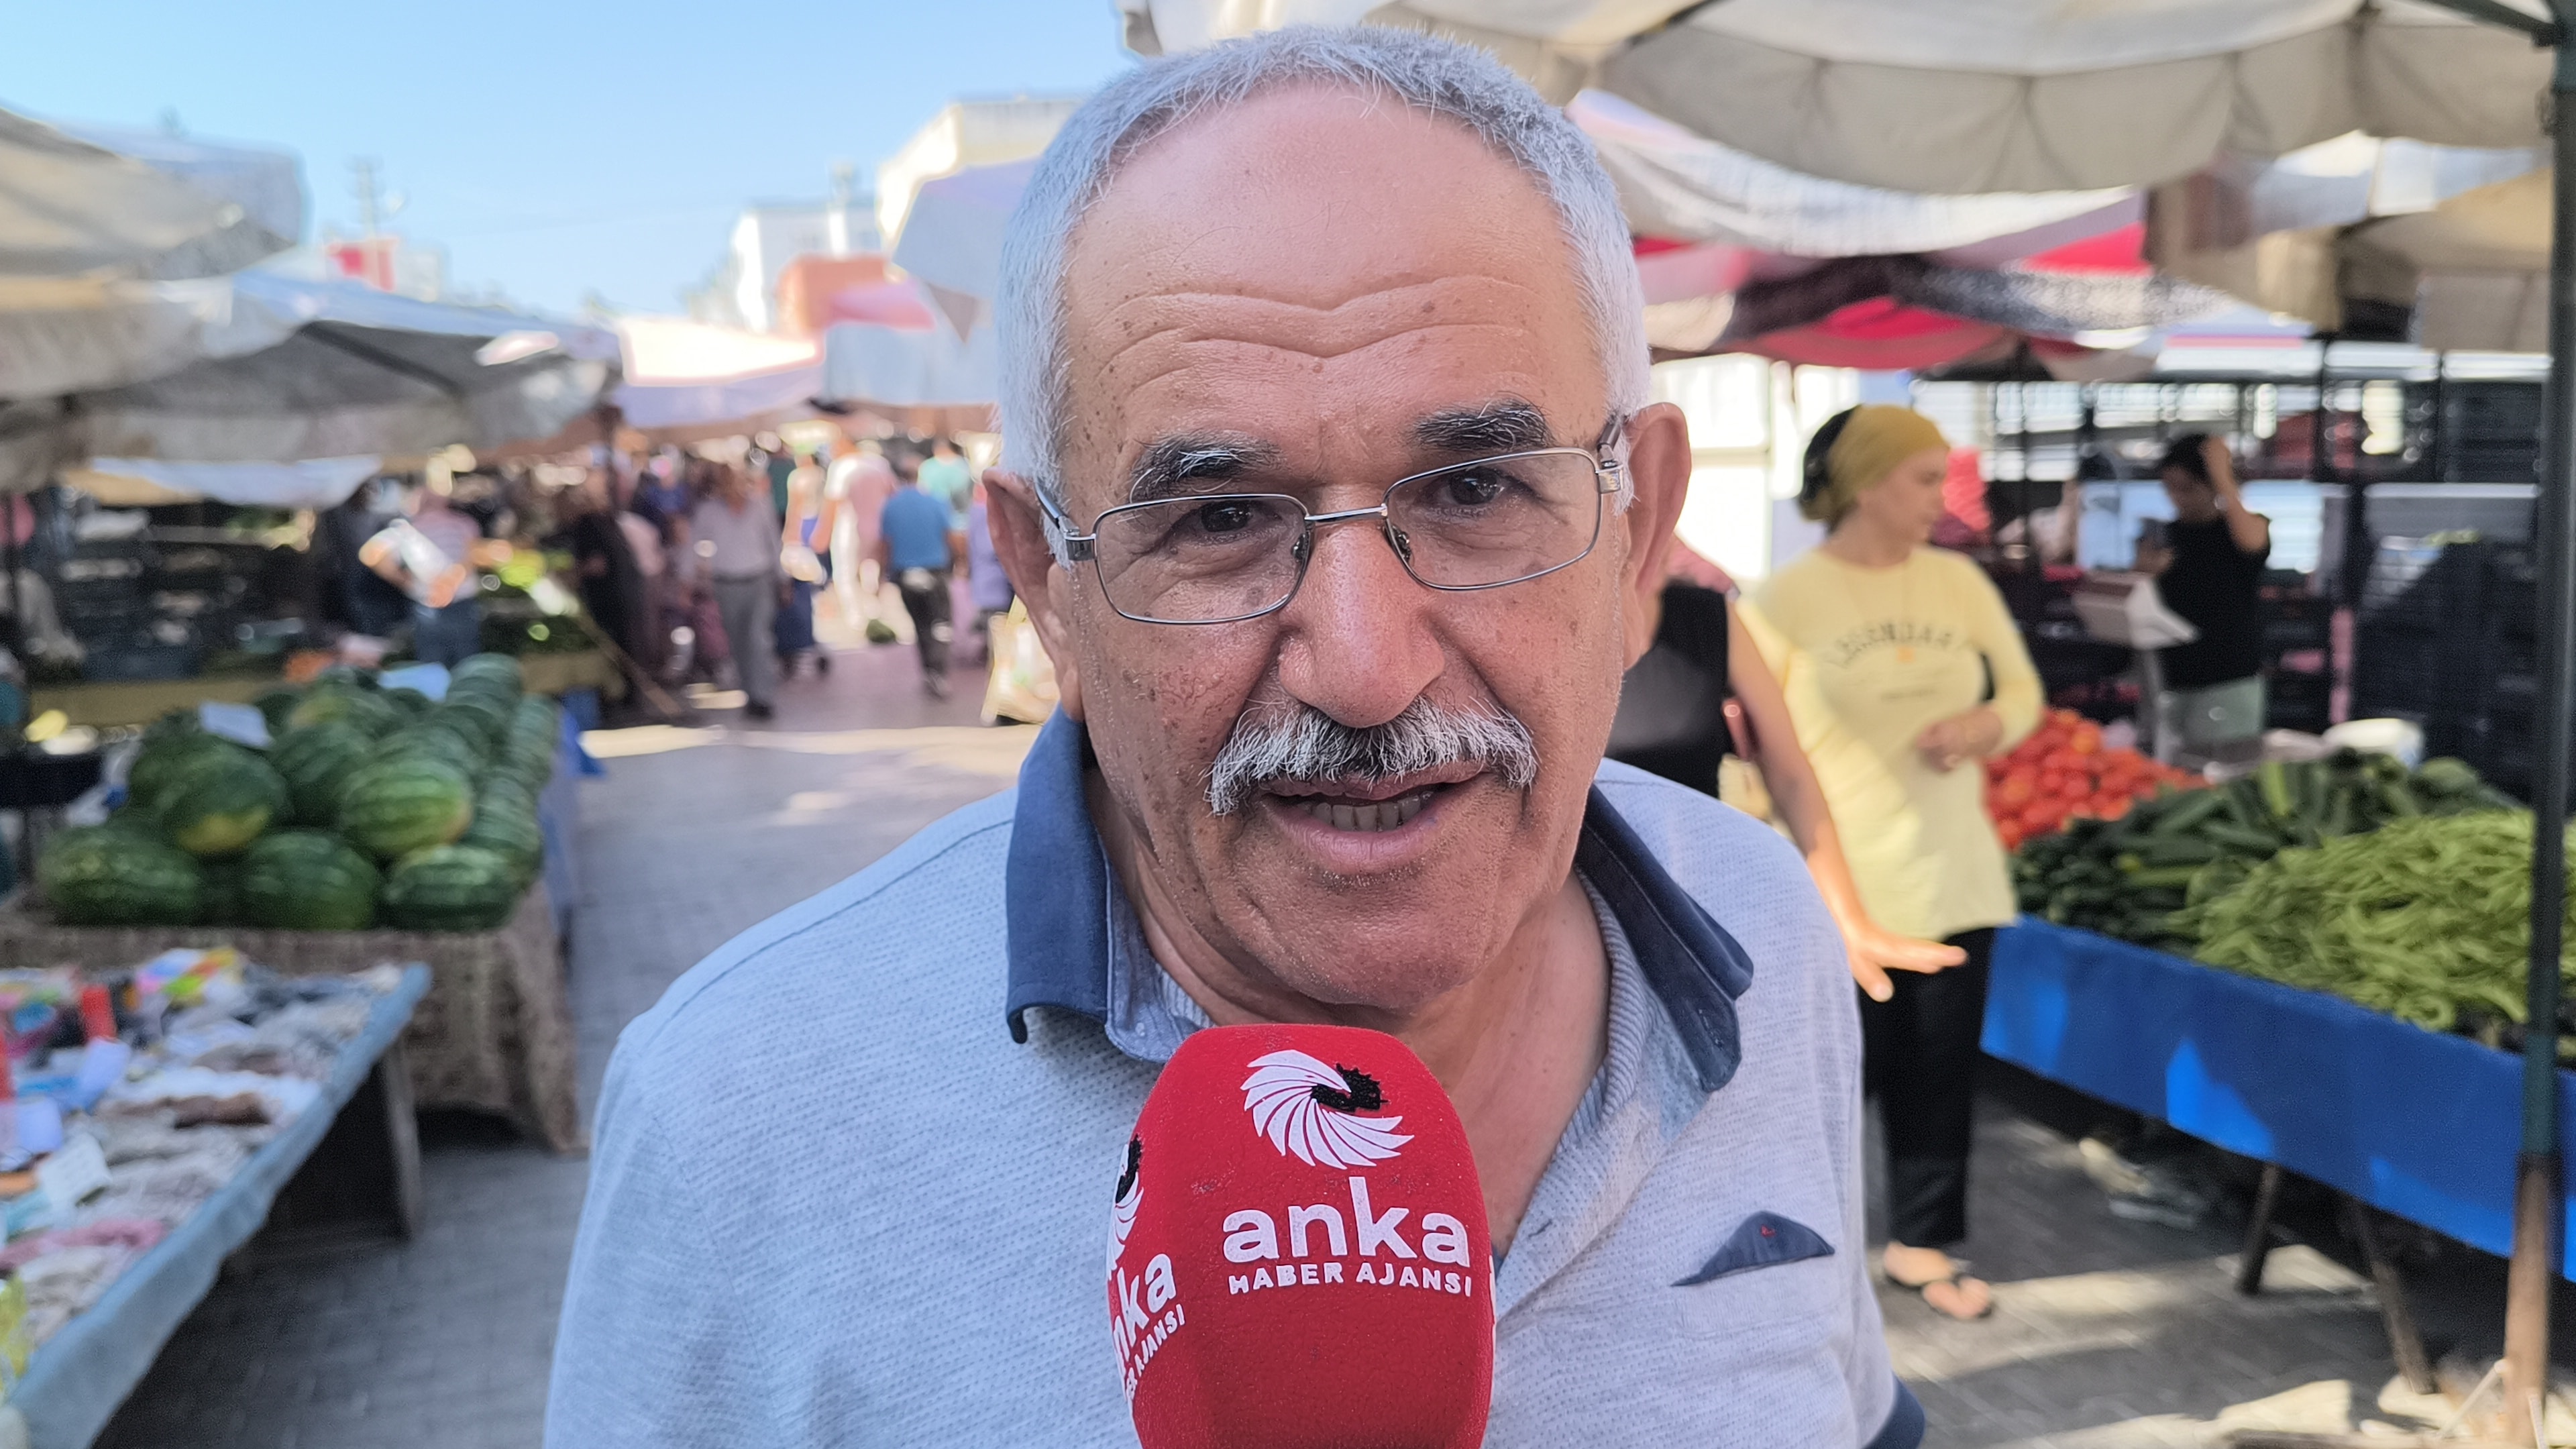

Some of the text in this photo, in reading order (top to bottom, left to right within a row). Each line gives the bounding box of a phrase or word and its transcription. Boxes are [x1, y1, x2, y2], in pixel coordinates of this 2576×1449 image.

[1223, 1177, 1470, 1267] anka
[1228, 1262, 1472, 1297] HABER AJANSI
[1113, 1254, 1177, 1401] nka
